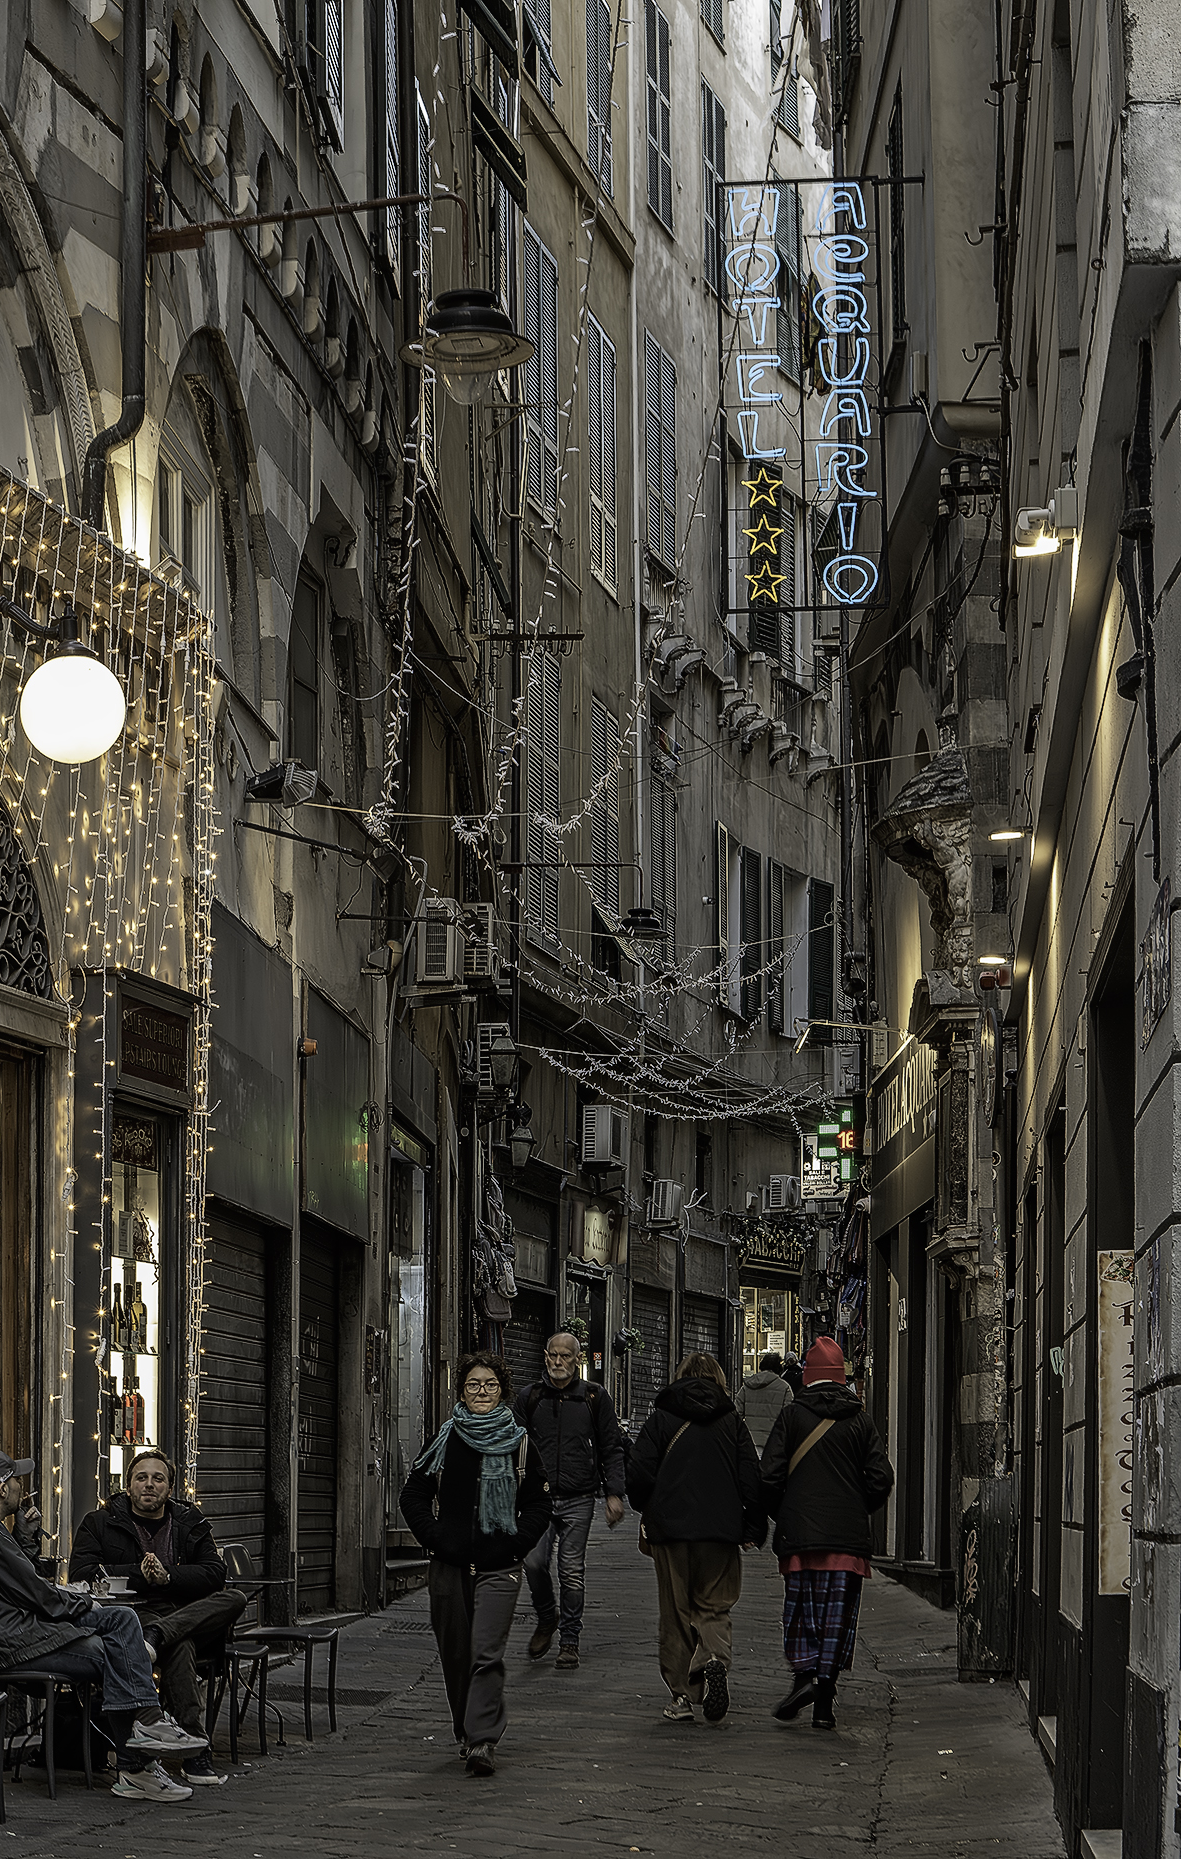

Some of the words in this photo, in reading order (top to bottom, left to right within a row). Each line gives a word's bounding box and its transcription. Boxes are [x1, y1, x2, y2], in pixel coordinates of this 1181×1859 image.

[725, 188, 787, 459] HOTEL
[812, 182, 878, 603] ACQUARIO
[877, 1074, 901, 1152] HOTEL
